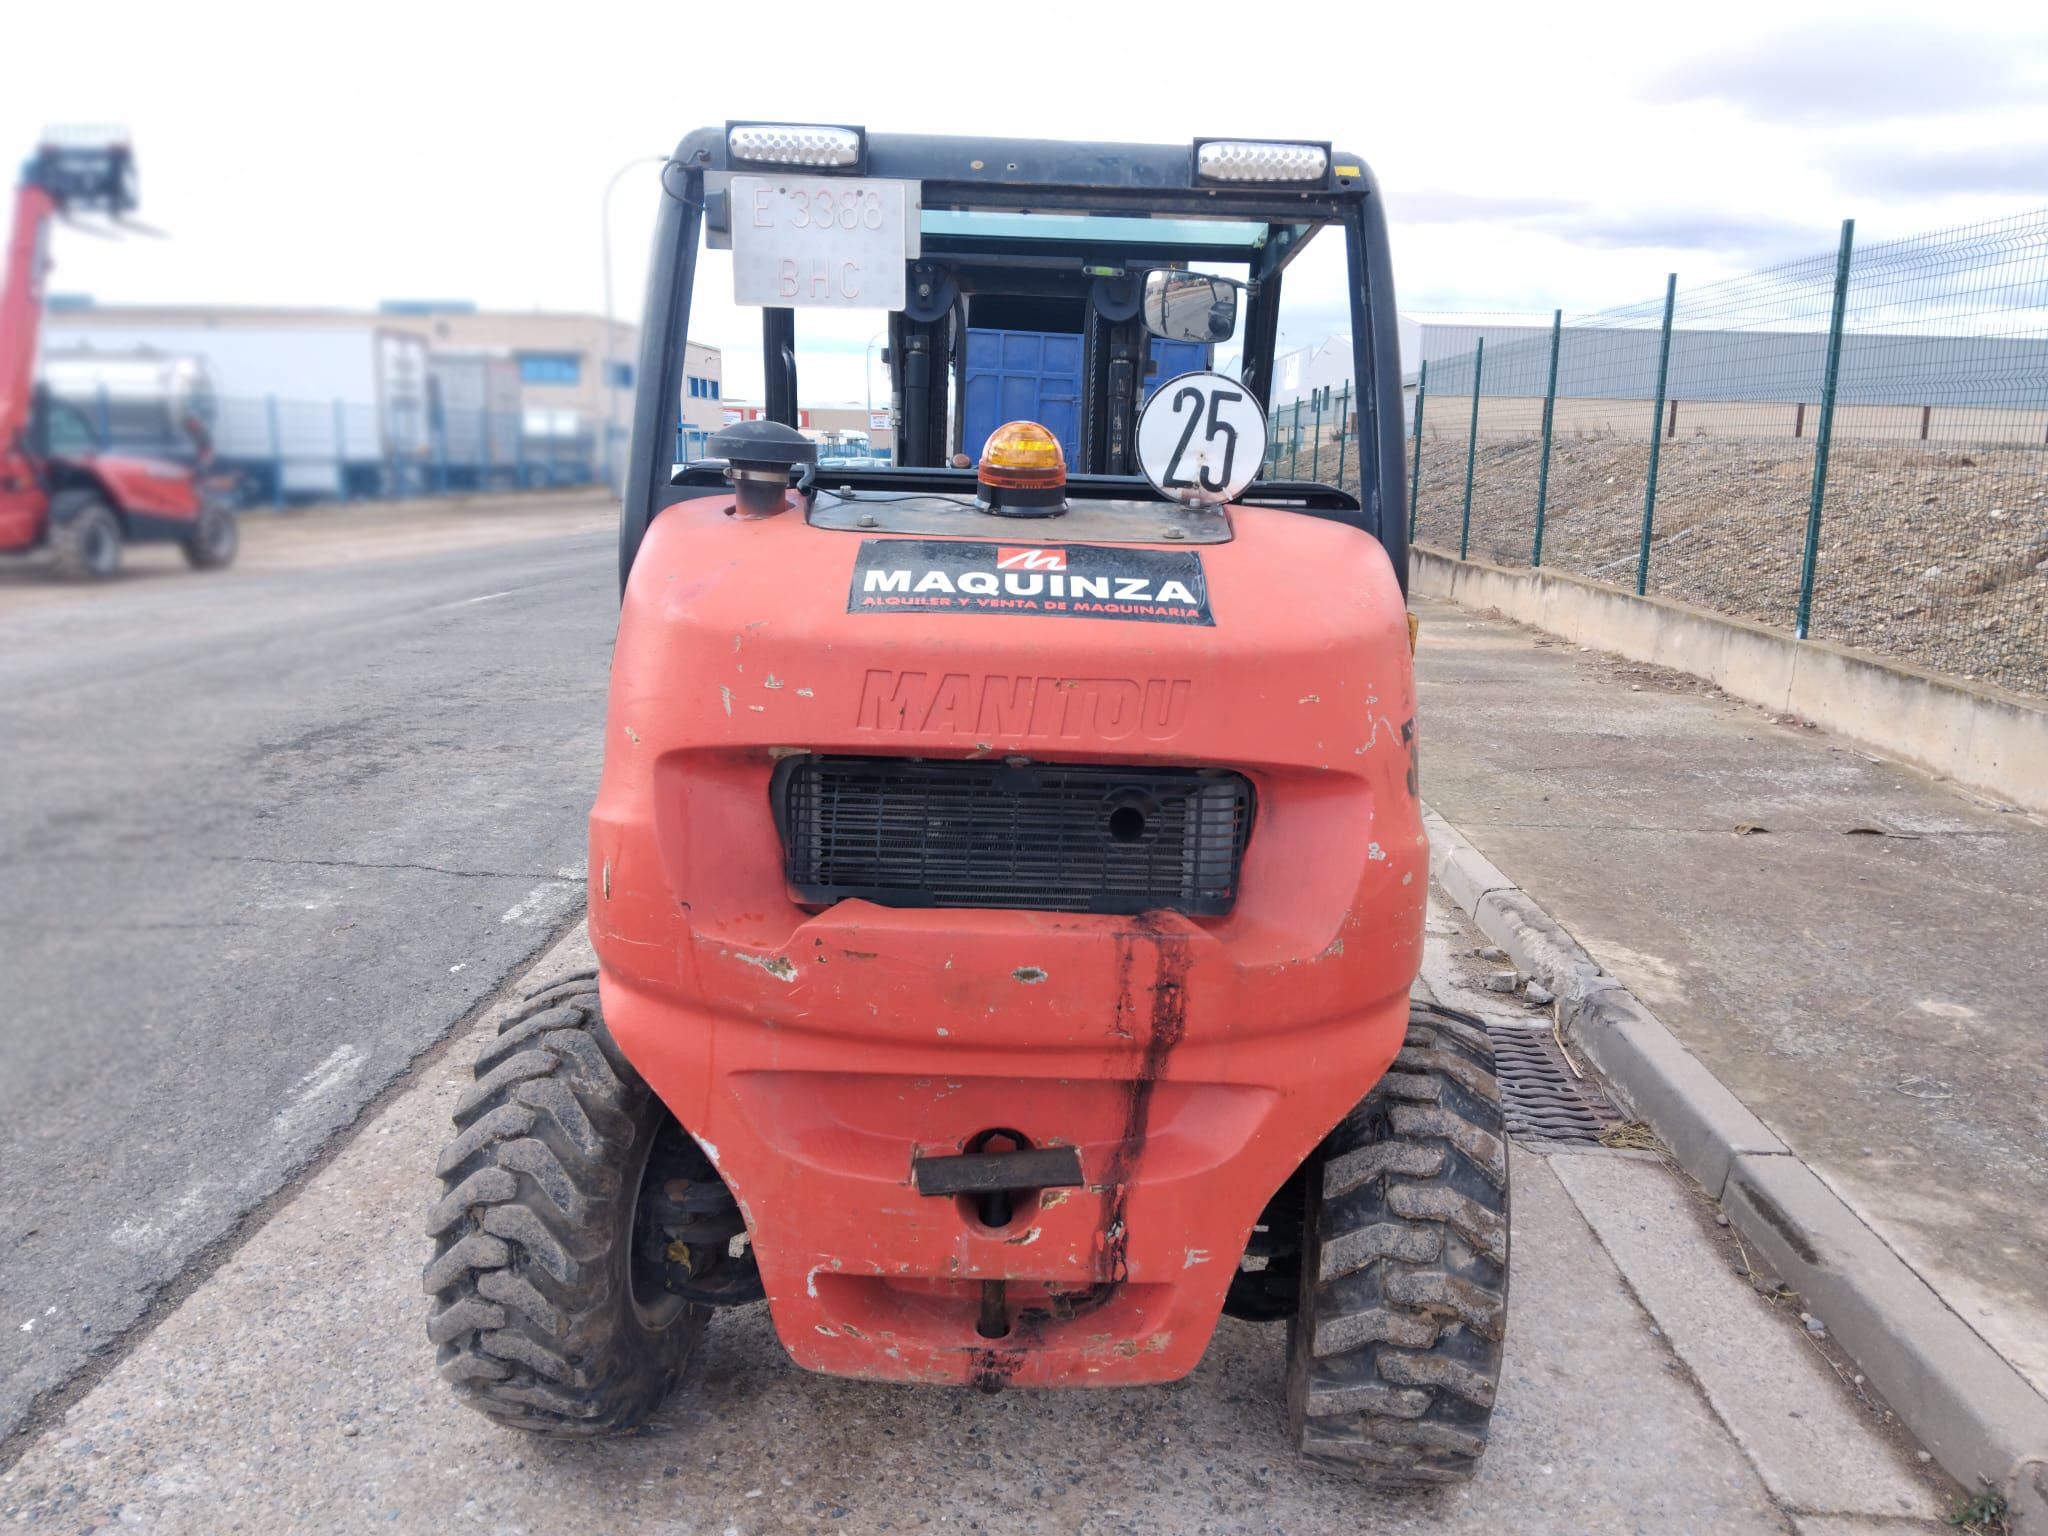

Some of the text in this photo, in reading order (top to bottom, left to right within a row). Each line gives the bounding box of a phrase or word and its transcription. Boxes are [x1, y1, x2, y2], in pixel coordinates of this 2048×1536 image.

[753, 187, 883, 231] E 3388
[778, 257, 861, 299] BHC
[1162, 386, 1242, 493] 25
[863, 569, 1198, 604] MAQUINZA
[863, 596, 1200, 618] ALQUILER Y VENTA DE MAQUINARIA
[855, 668, 1192, 740] MANITOU
